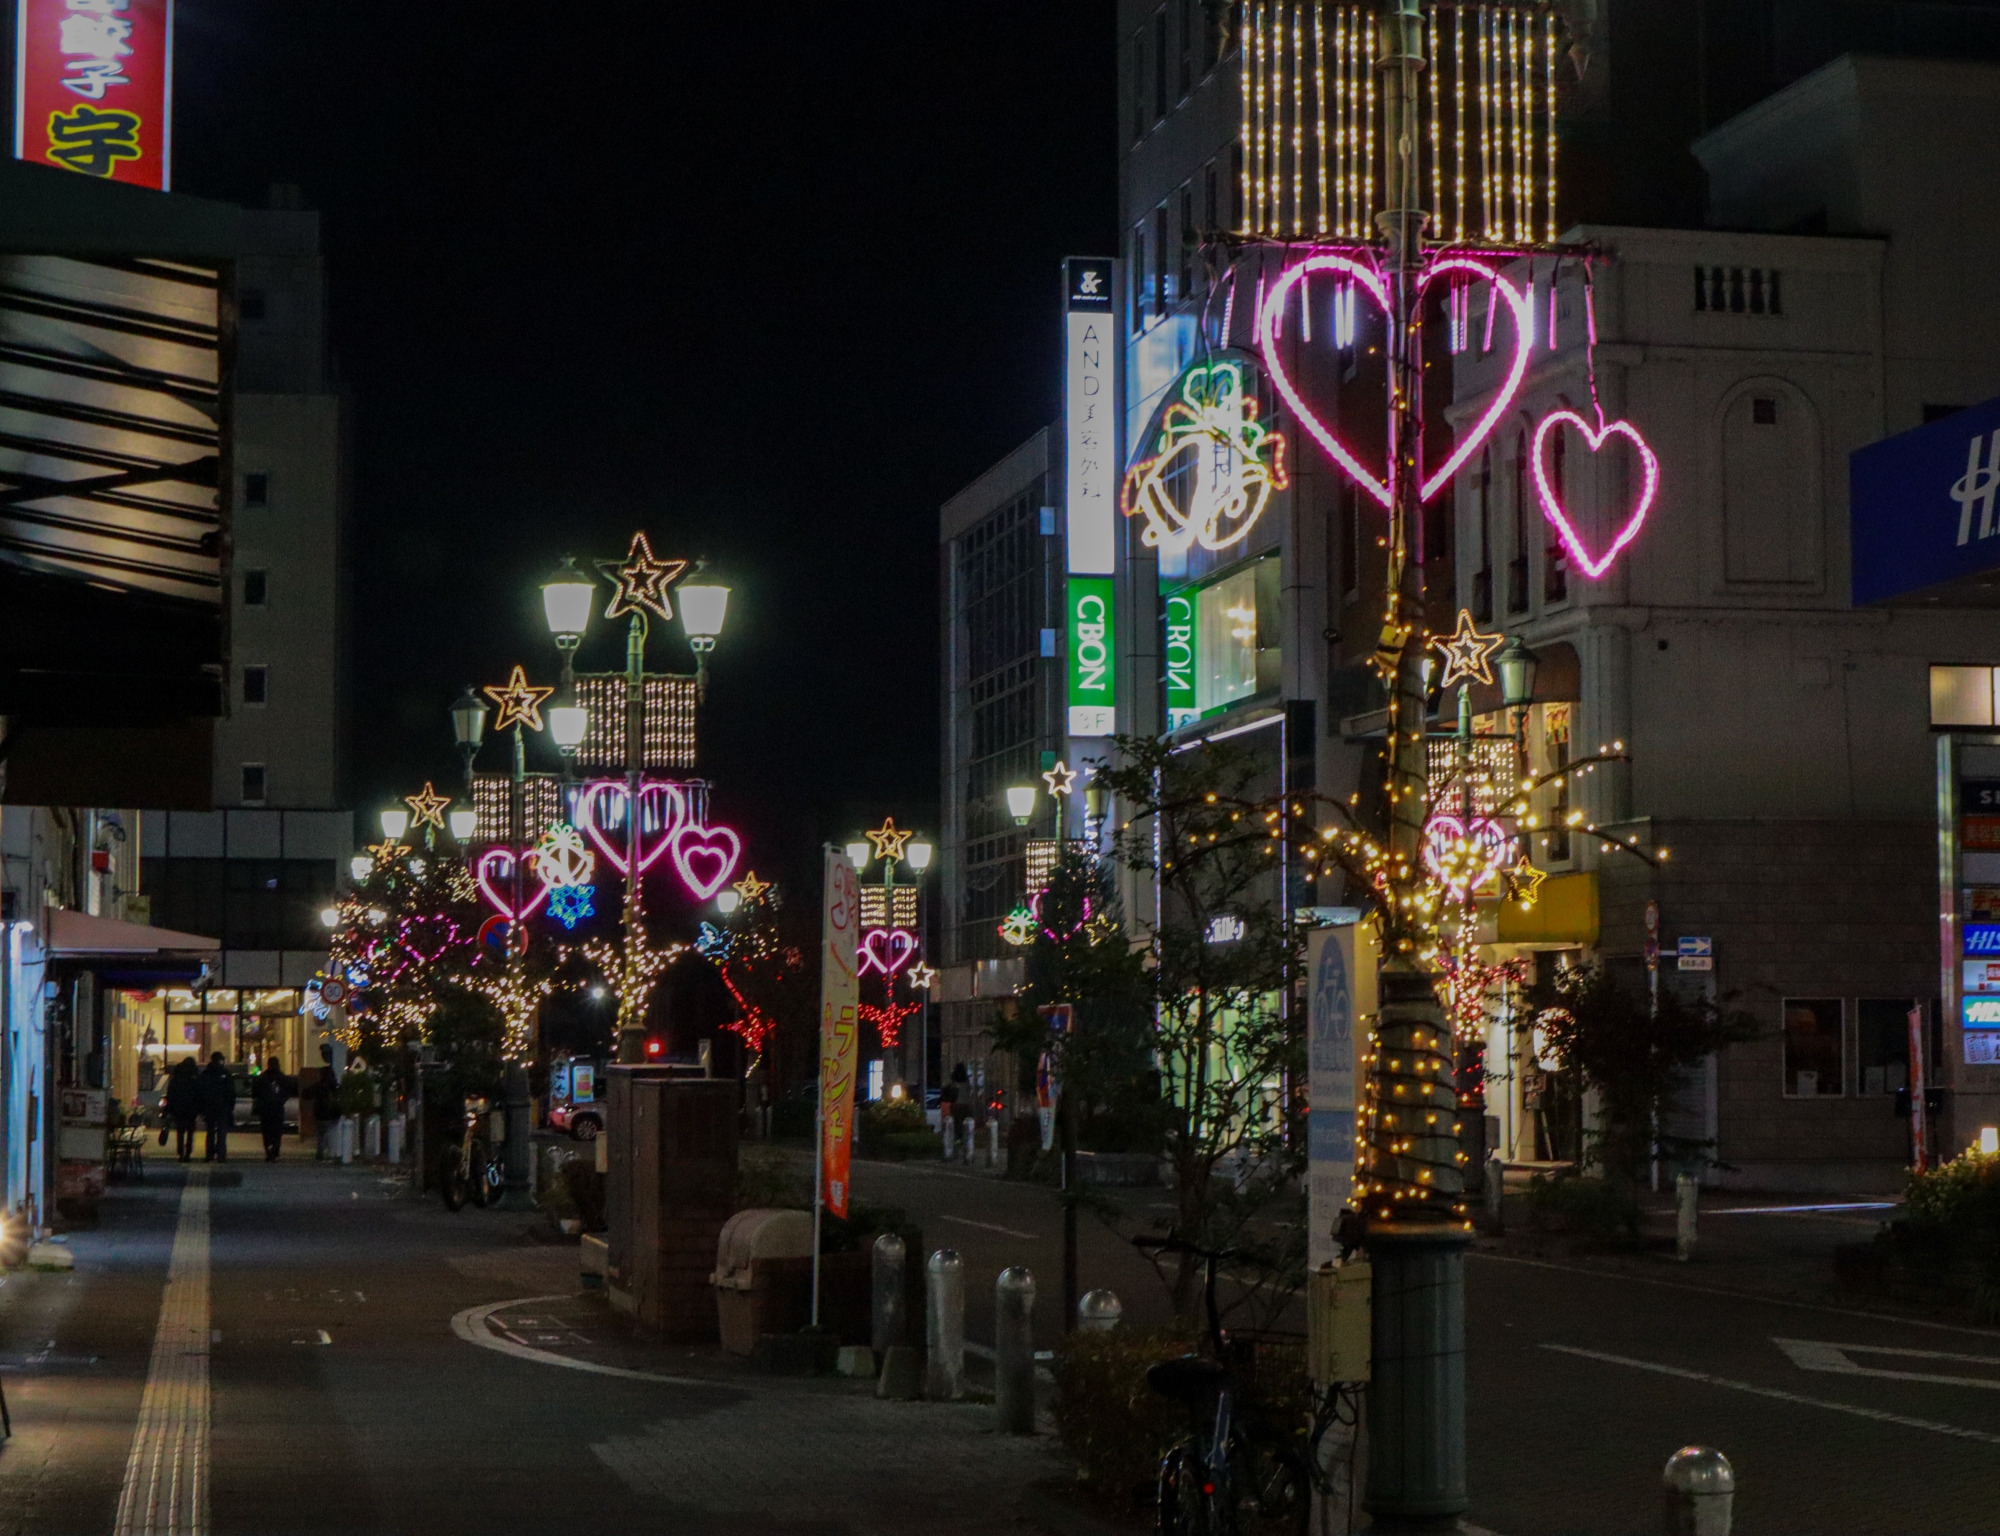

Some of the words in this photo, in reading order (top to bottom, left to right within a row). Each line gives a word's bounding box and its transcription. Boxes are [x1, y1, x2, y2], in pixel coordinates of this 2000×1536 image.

[1077, 594, 1106, 691] CBON
[326, 985, 341, 998] 30
[829, 1005, 855, 1153] ランチ
